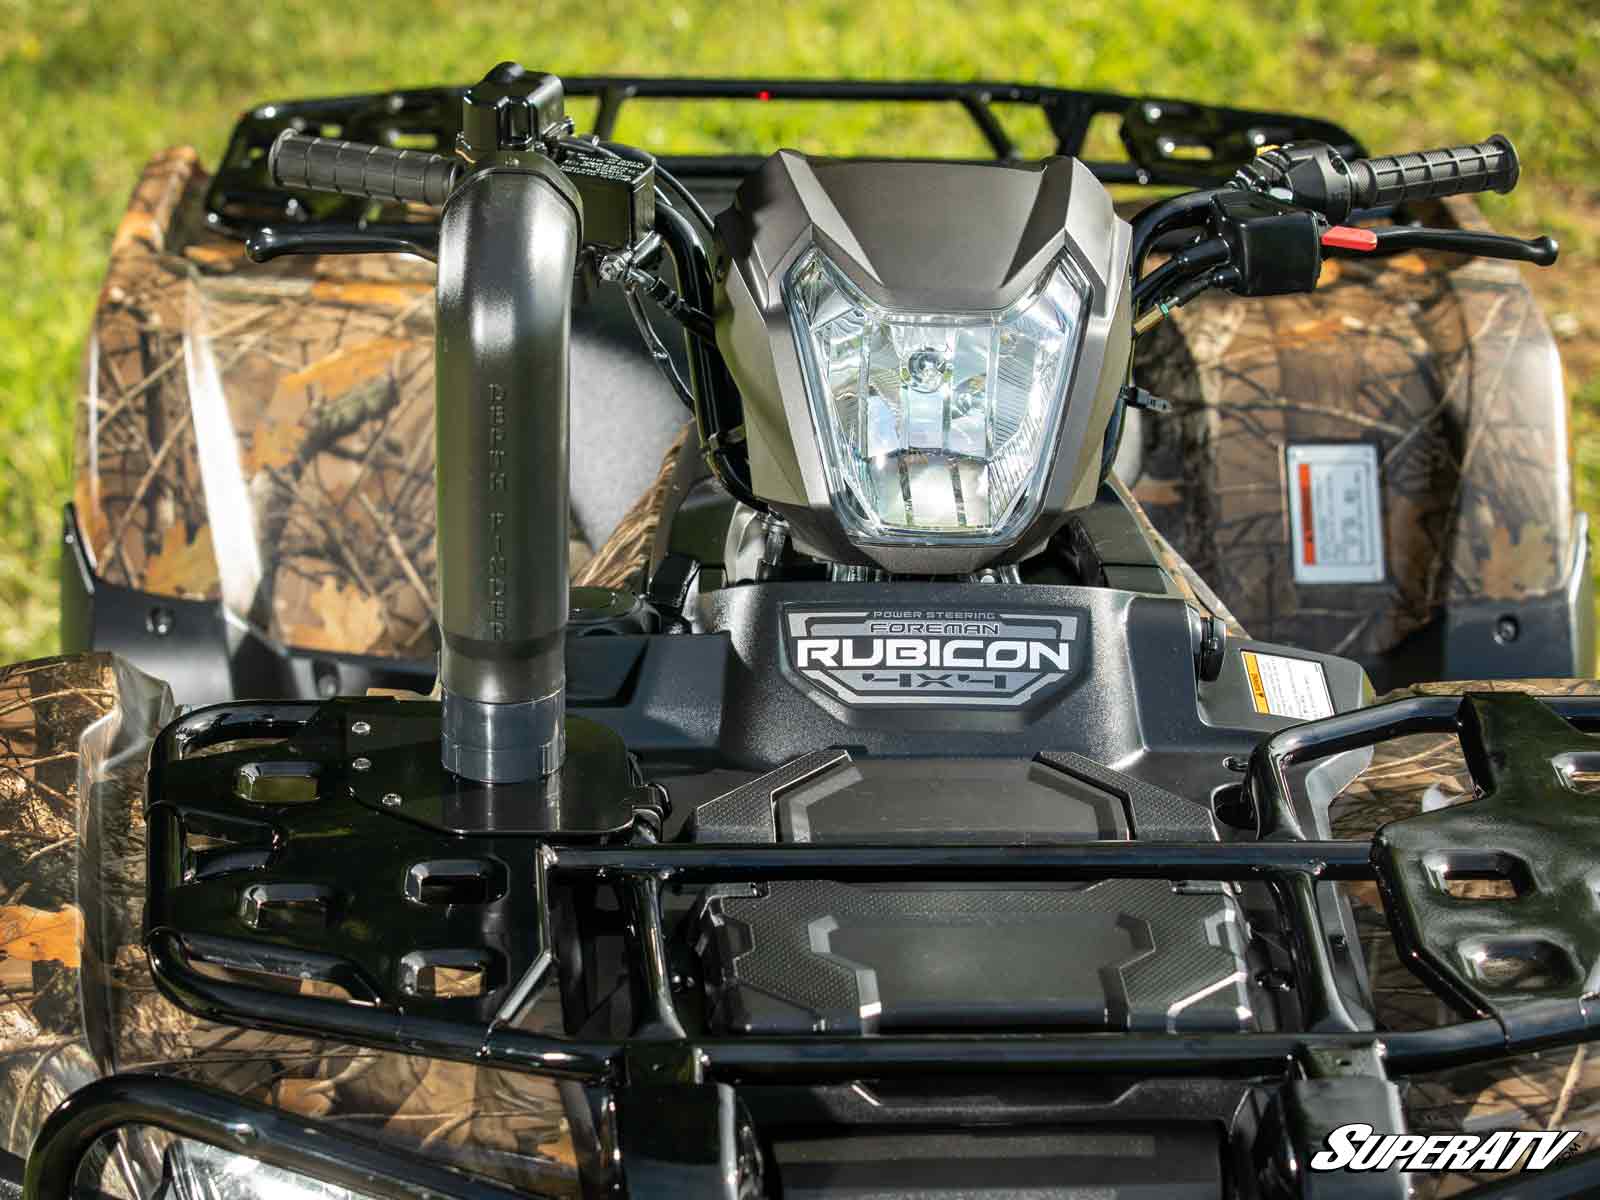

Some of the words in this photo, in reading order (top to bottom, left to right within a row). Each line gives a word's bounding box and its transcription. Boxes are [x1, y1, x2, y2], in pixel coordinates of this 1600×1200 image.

[488, 383, 506, 490] DEPTH
[488, 513, 506, 640] FINDER
[870, 622, 1000, 635] FOREMAN
[873, 610, 923, 619] POWER
[926, 610, 996, 620] STEERING
[797, 639, 1070, 670] RUBICON
